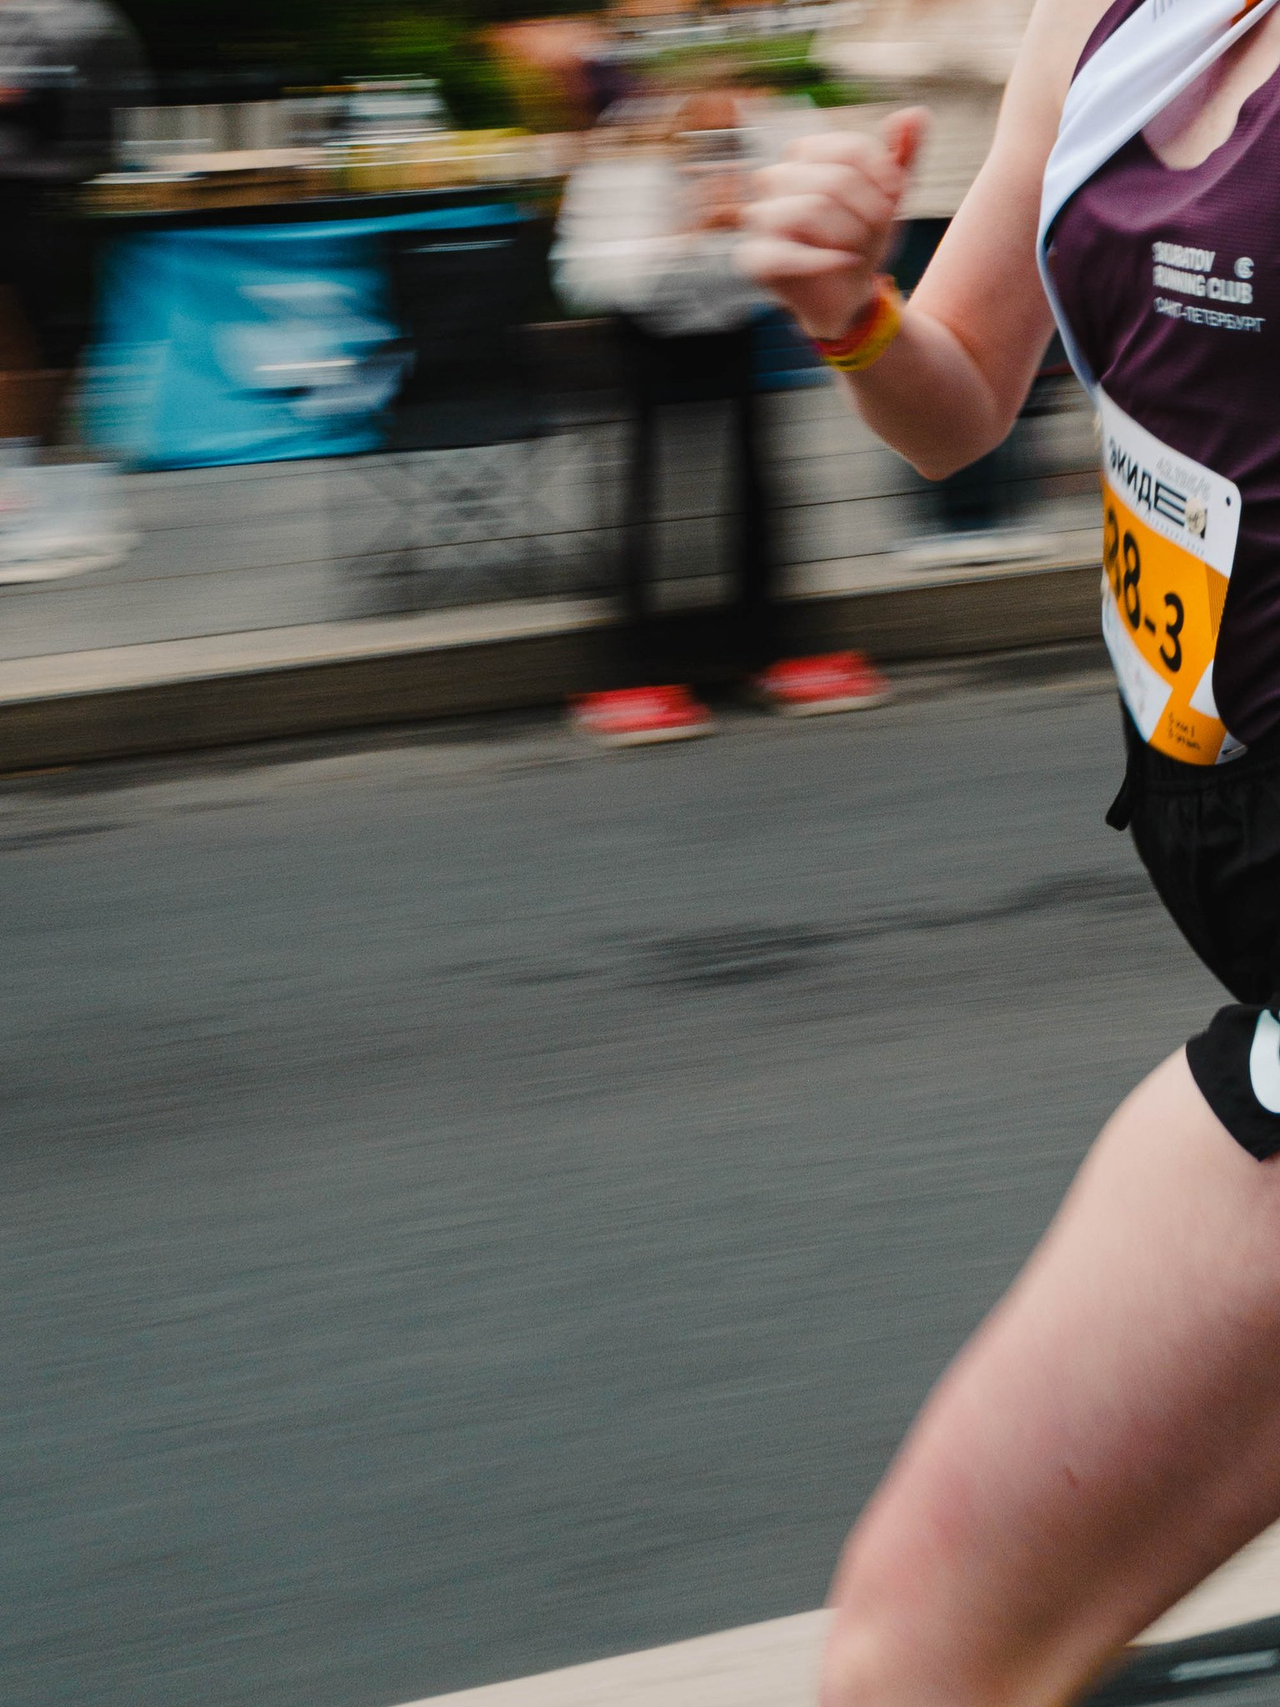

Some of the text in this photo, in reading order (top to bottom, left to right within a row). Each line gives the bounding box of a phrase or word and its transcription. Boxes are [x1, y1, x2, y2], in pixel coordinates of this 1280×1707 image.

[1152, 264, 1253, 305] RUNNING CLUB
[1109, 435, 1208, 540] ЭКИДЕ
